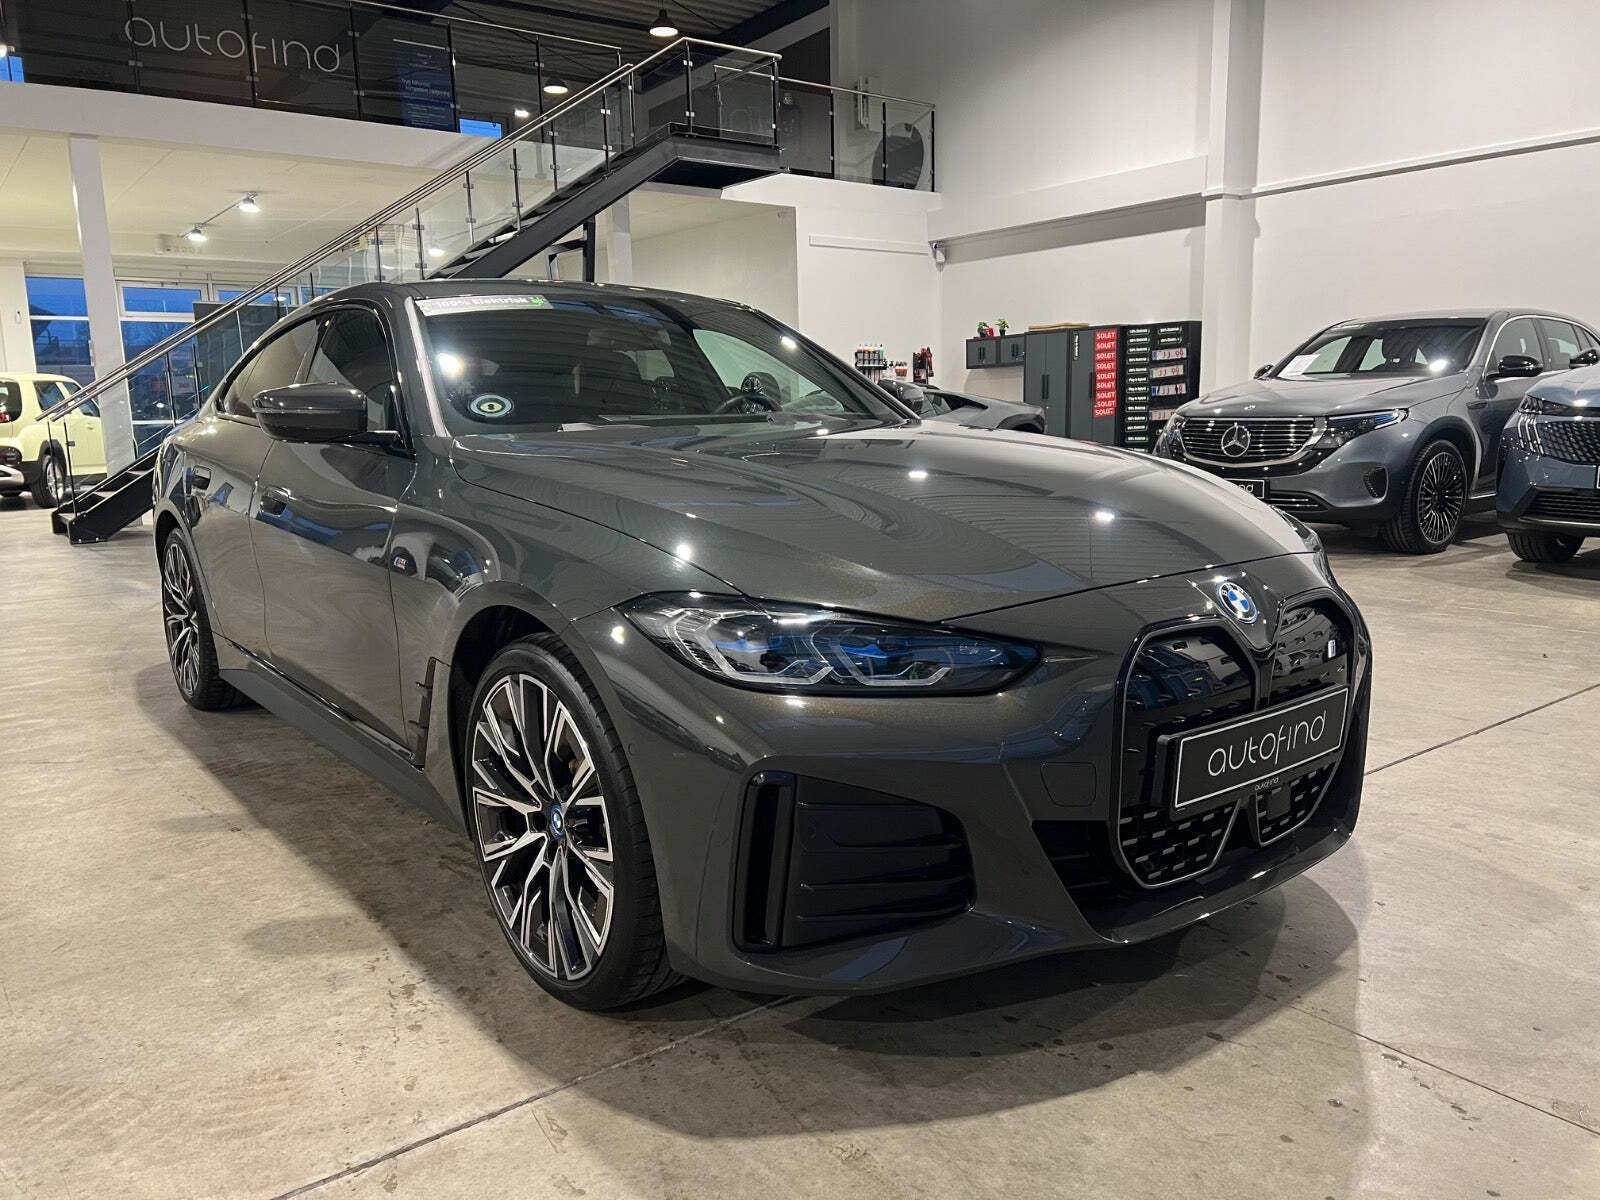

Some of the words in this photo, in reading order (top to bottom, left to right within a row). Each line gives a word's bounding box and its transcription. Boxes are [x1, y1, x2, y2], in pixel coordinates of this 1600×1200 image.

[125, 17, 340, 73] autofind
[1096, 332, 1115, 340] SOLGT
[1208, 709, 1327, 777] autofind
